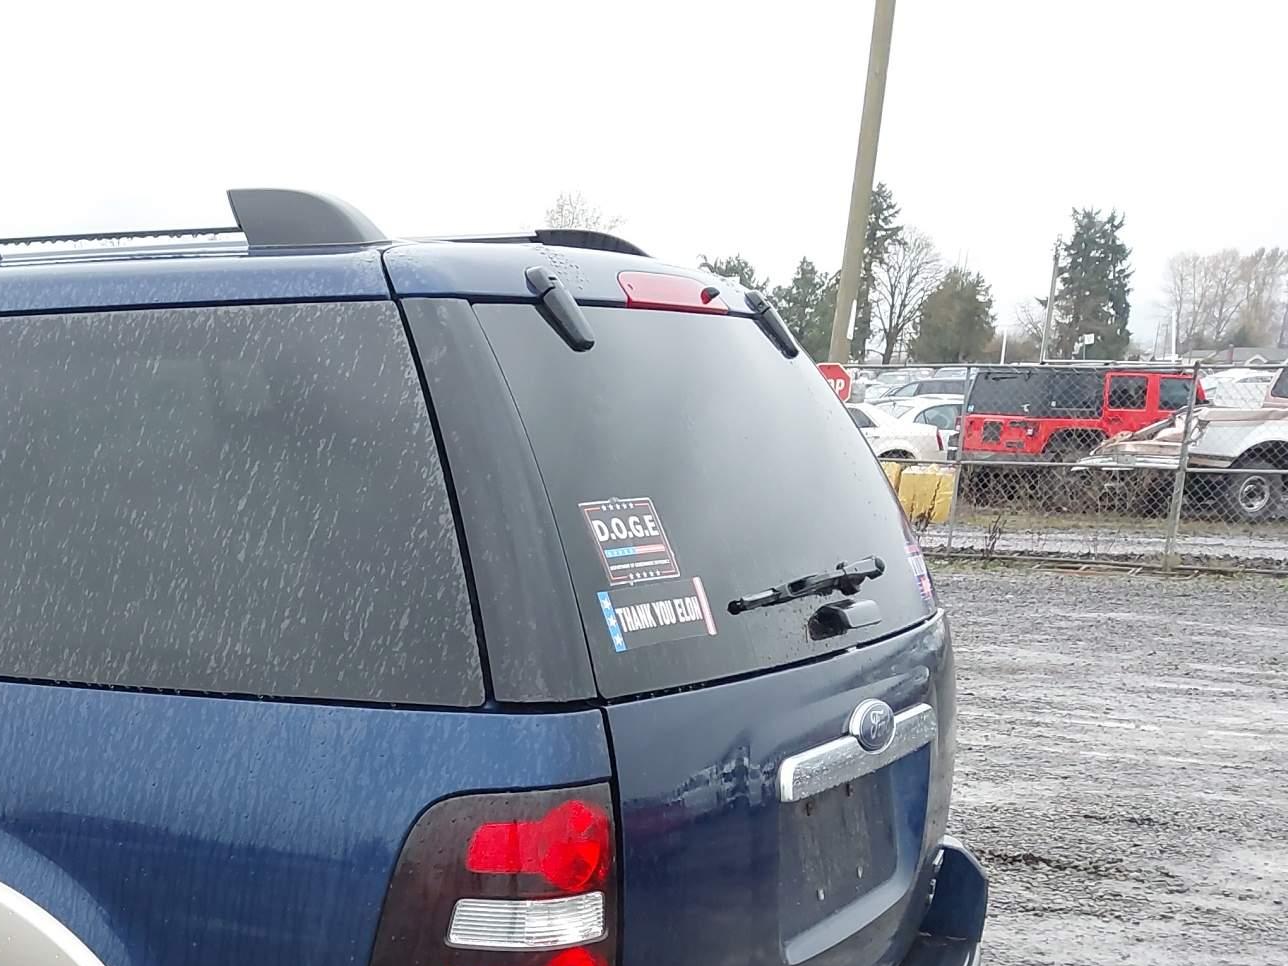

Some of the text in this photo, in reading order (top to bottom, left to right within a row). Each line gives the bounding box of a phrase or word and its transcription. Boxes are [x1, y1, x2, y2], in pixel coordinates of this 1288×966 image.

[592, 514, 660, 542] D.O.G.E
[615, 596, 703, 632] THANK YOU ELON
